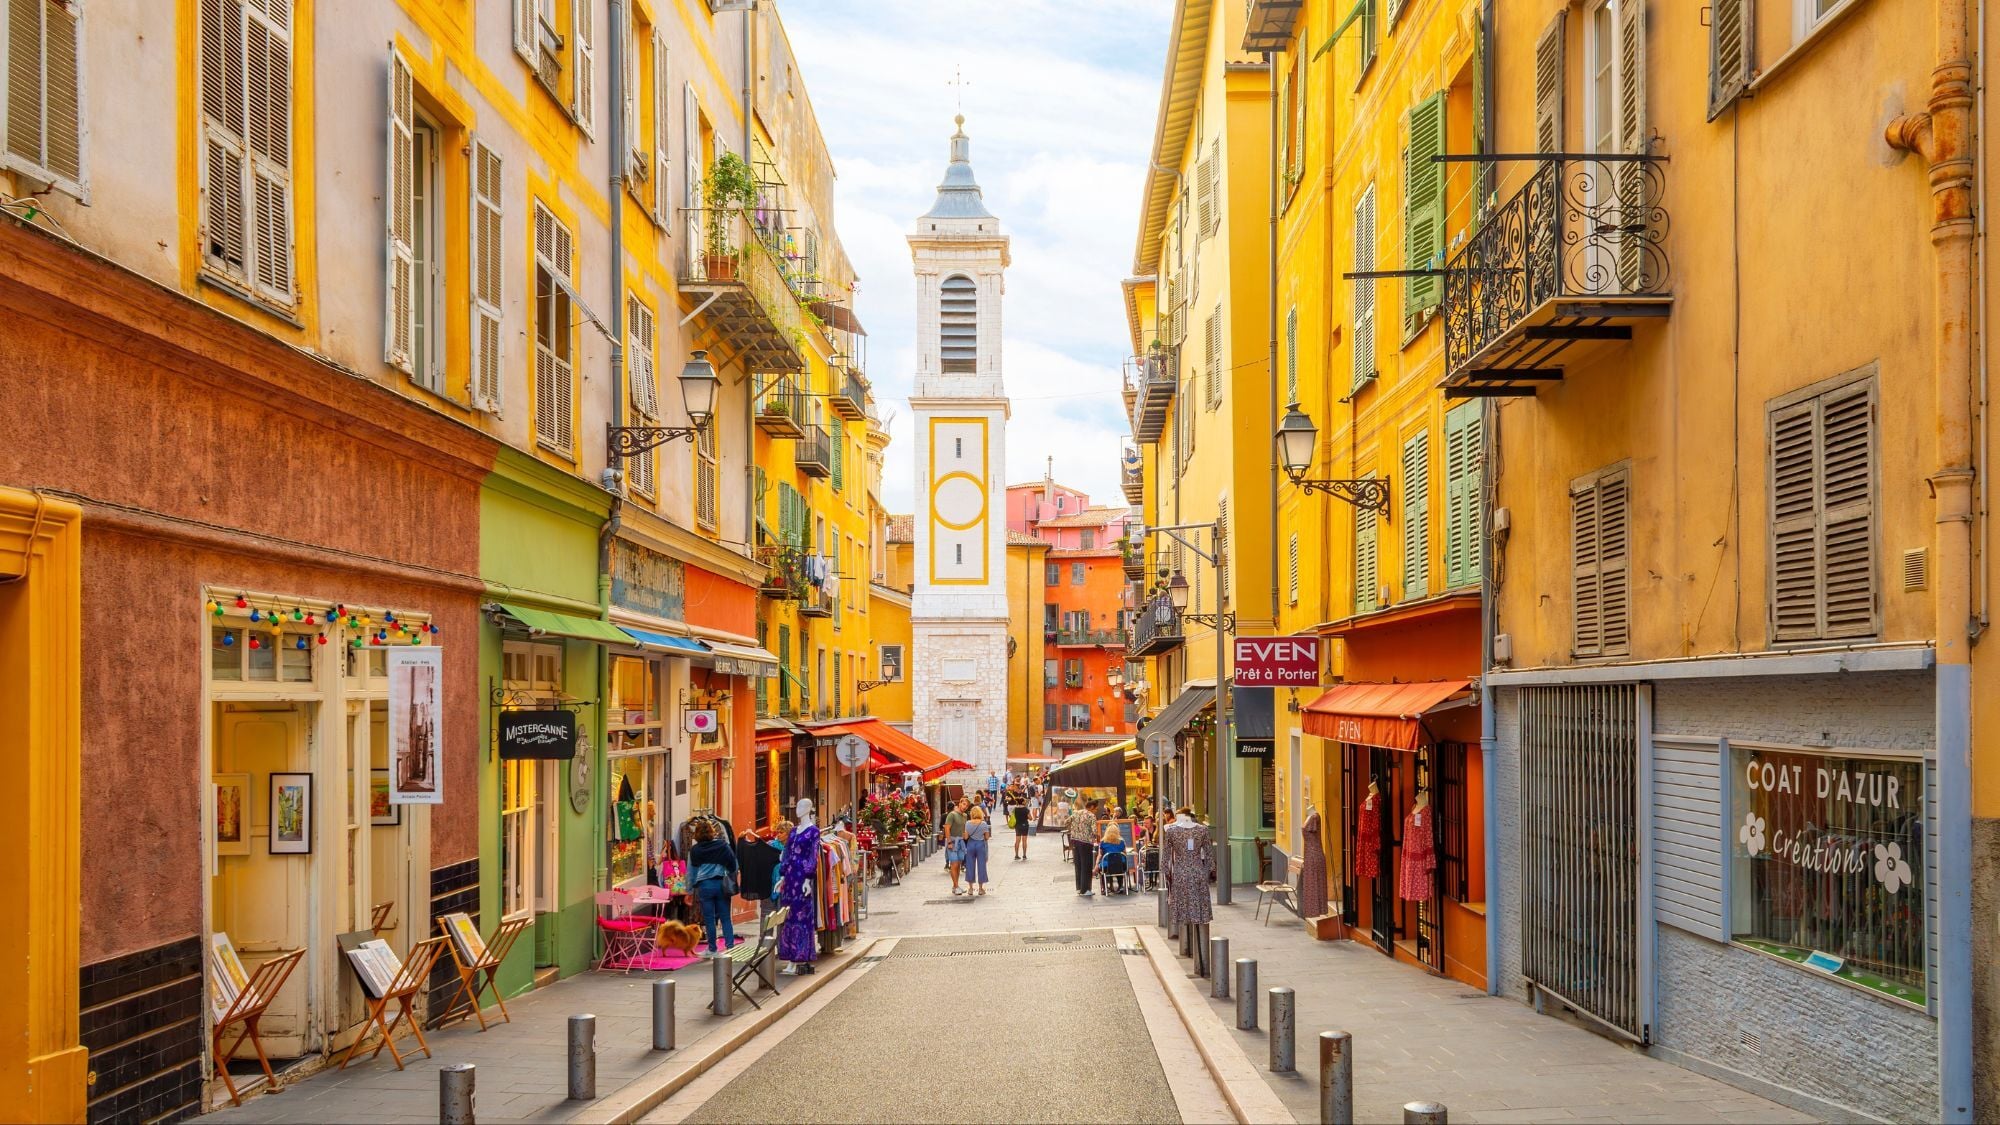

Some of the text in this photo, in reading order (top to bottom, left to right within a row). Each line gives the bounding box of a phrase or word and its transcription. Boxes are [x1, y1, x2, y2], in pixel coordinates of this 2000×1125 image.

[1236, 642, 1316, 662] EVEN
[1235, 667, 1318, 680] Prêt à Porter
[1339, 720, 1361, 739] EVEN
[1241, 745, 1267, 753] Bistrot
[1746, 760, 1900, 809] COAT D'AZUR
[1773, 829, 1867, 874] Créations
